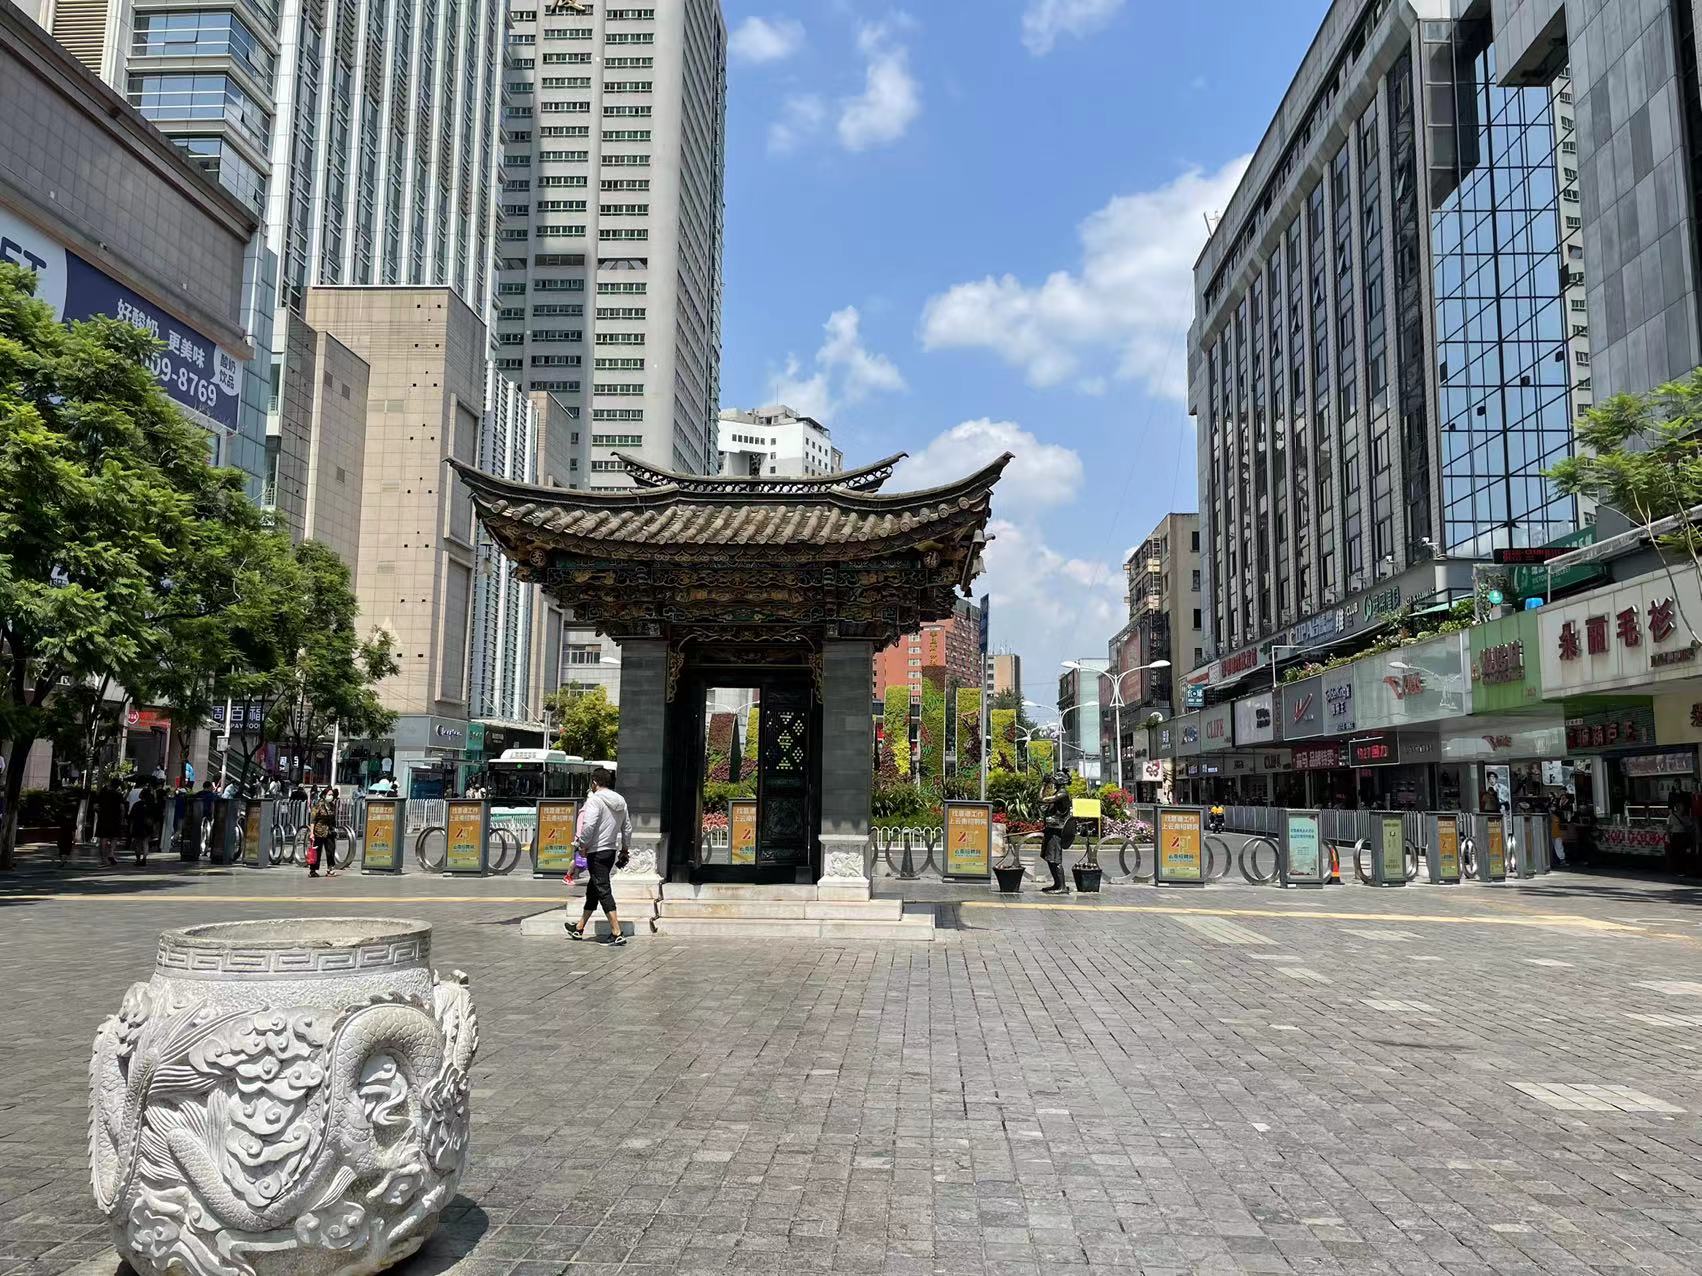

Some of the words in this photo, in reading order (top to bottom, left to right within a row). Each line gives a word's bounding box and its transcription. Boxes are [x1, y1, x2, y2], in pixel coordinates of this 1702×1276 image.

[168, 329, 206, 369] 更美味
[219, 352, 236, 375] 酸奶
[219, 369, 235, 390] 饮品
